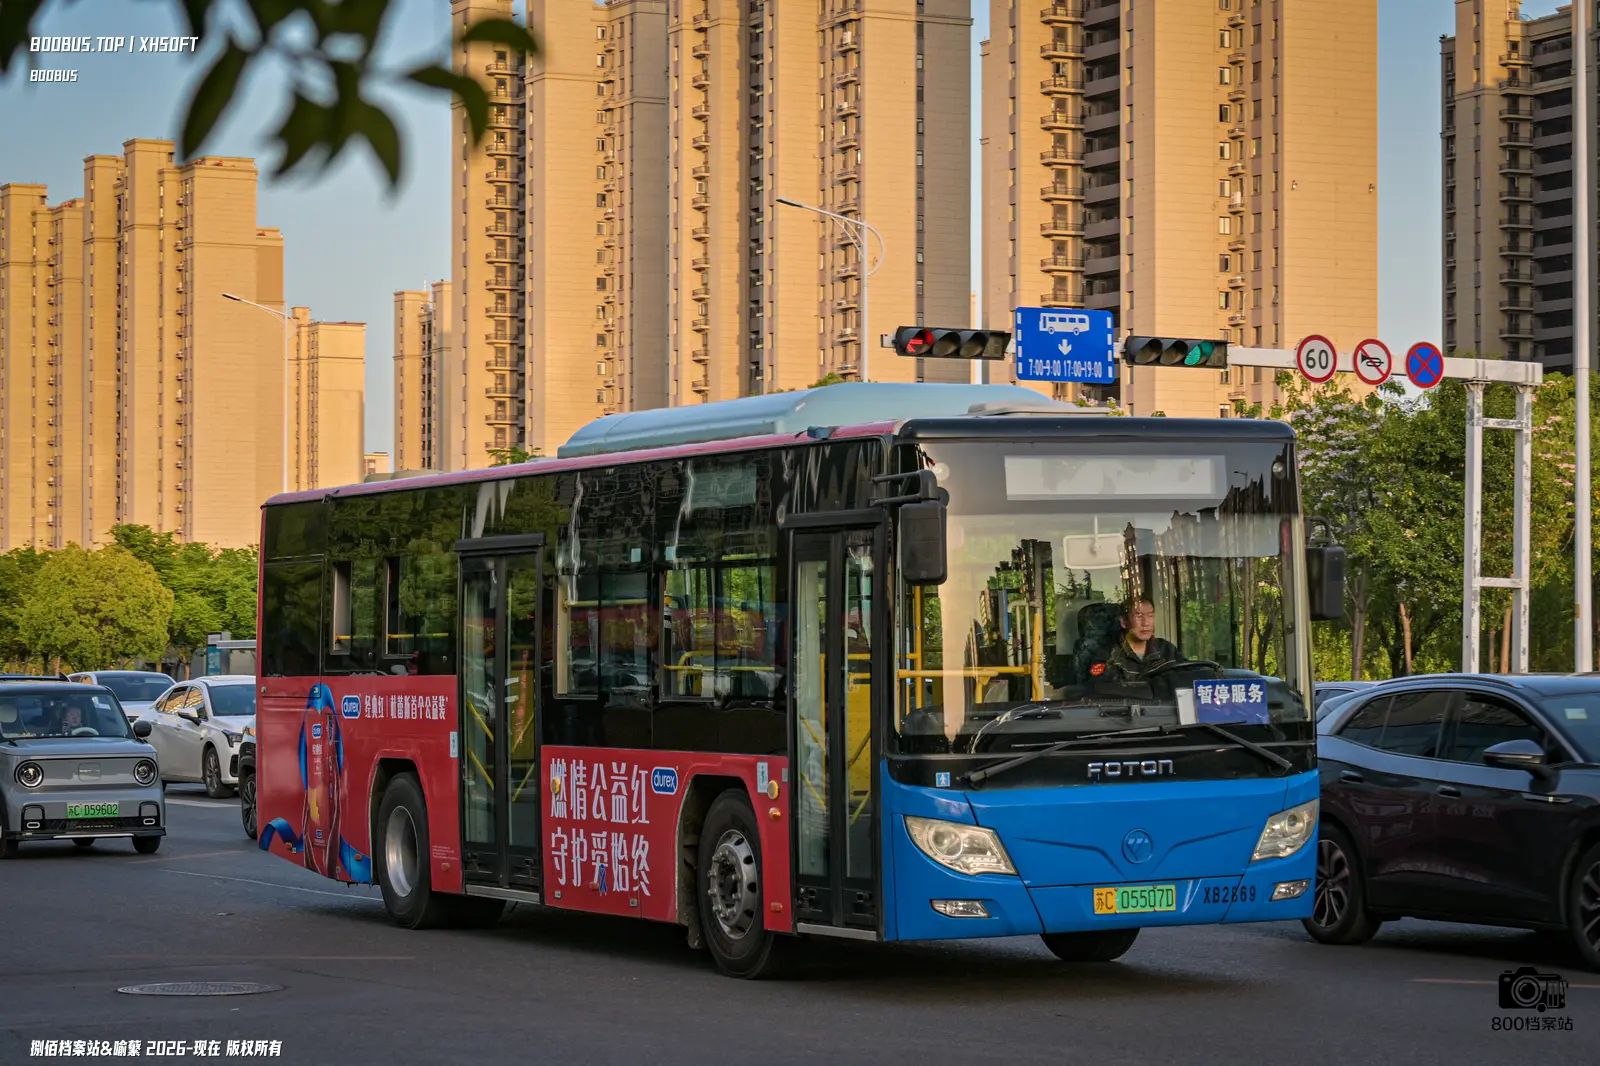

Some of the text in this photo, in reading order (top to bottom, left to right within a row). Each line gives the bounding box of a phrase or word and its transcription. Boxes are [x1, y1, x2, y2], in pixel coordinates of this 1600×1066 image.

[1028, 358, 1103, 378] 7:00-9:00 17:00-19:00
[1305, 348, 1329, 370] 60
[1197, 683, 1263, 705] 暂停服务
[1087, 759, 1174, 778] FOTON
[653, 770, 676, 791] durex
[550, 758, 650, 825] 燃情公益红
[84, 803, 118, 816] D59602
[551, 826, 651, 897] 守护爱始终
[1095, 888, 1174, 911] 苏C 05507D
[1203, 885, 1257, 904] XB2869
